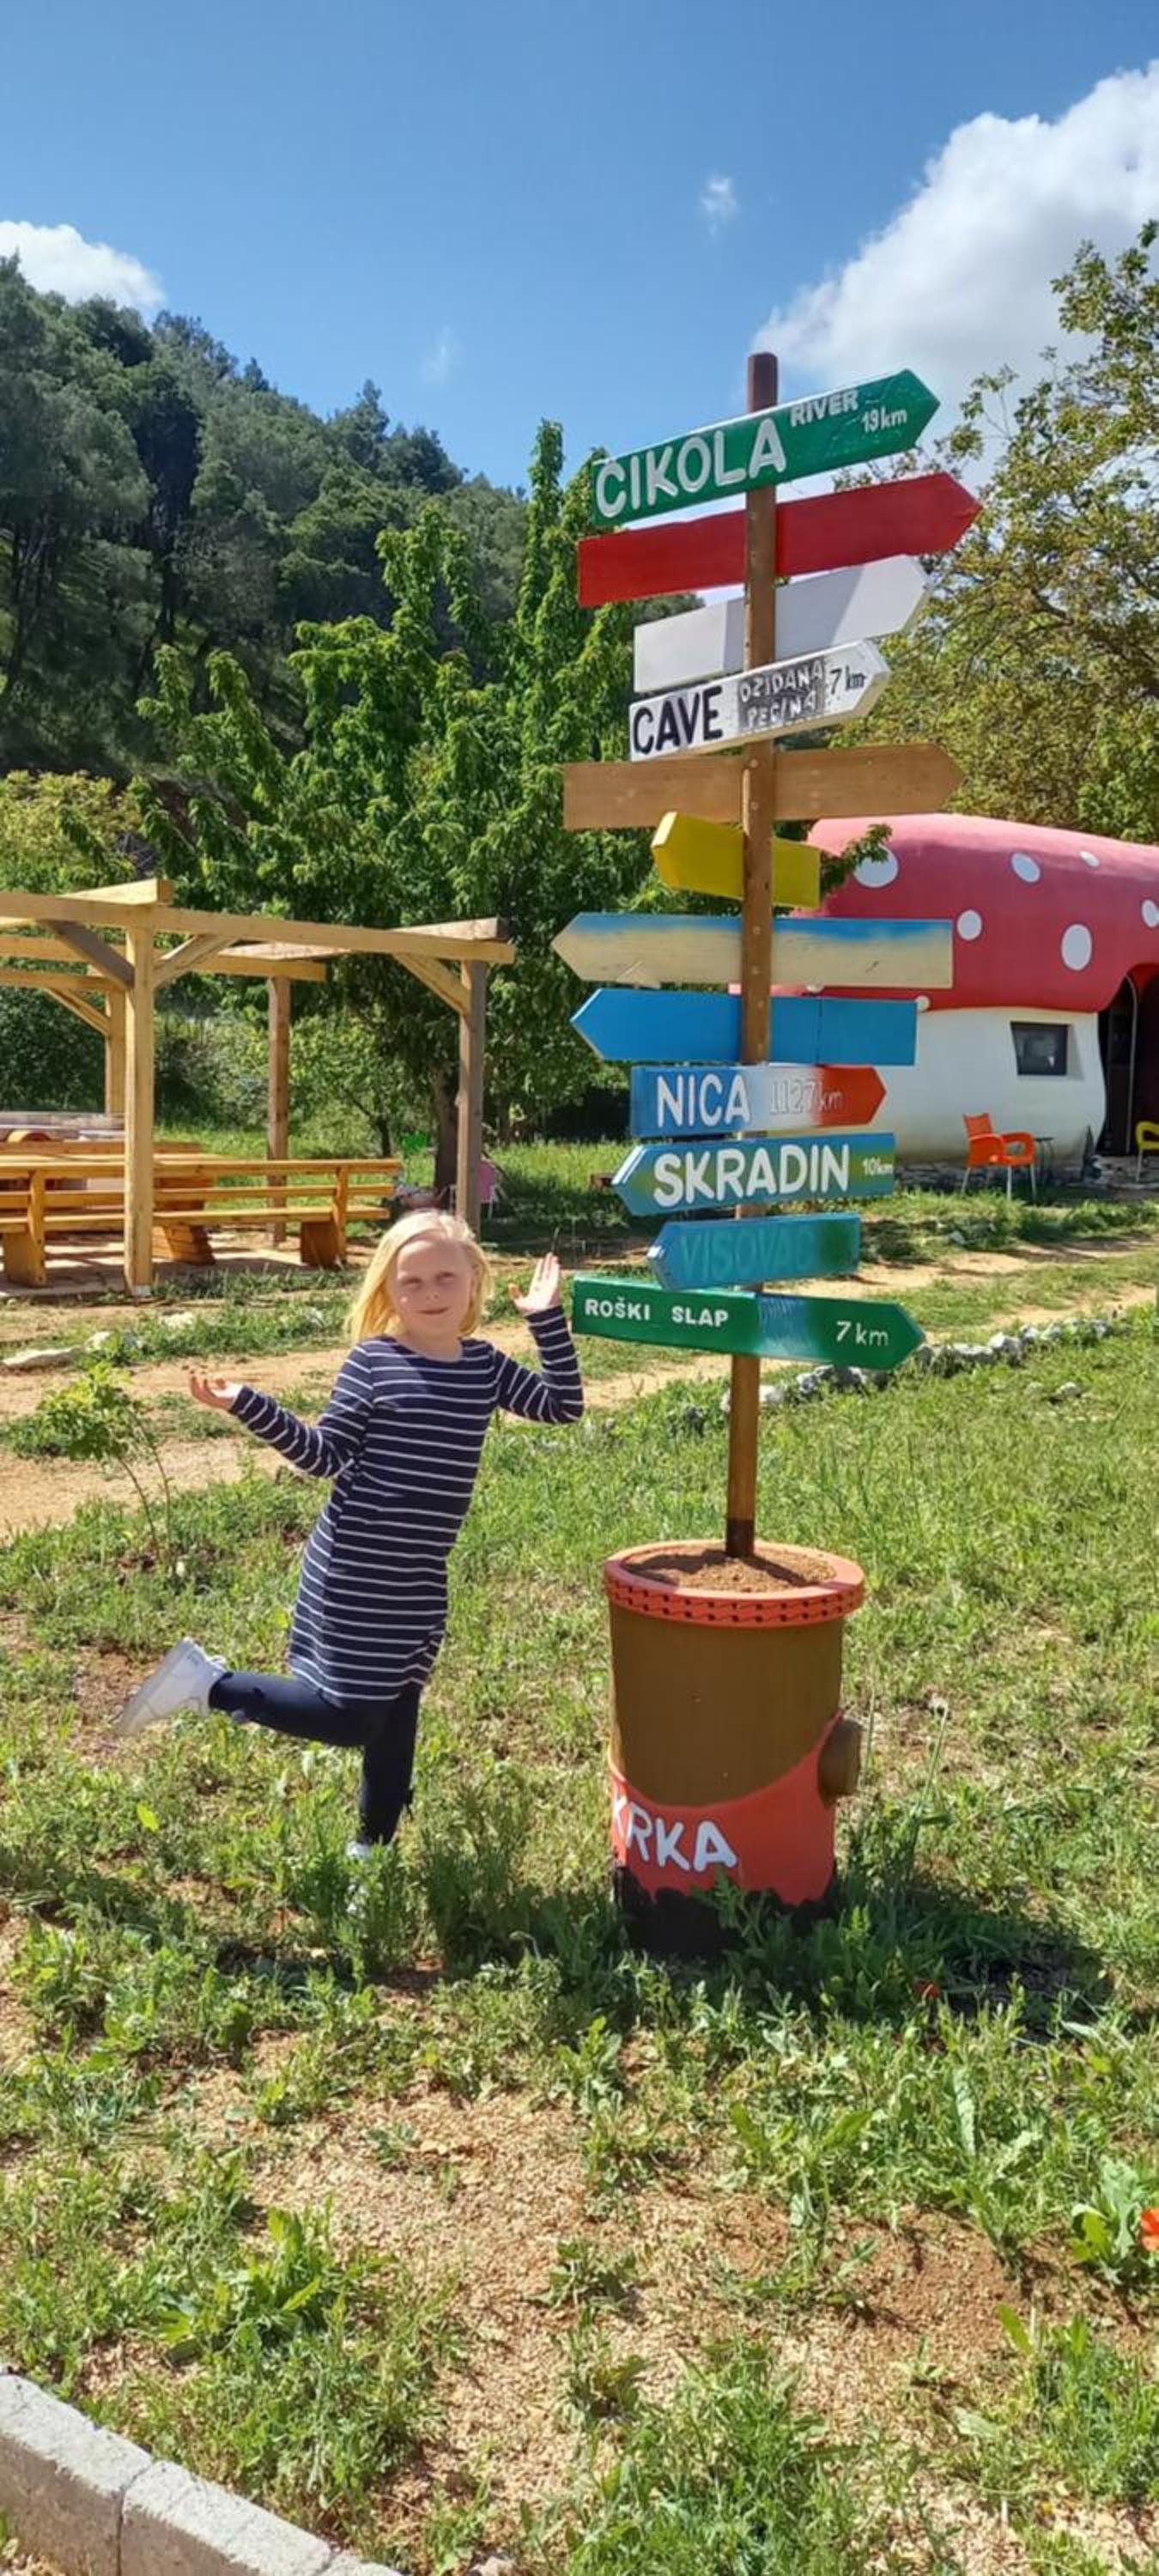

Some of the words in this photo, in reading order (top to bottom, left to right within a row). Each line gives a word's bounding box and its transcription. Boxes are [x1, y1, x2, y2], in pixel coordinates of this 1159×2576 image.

[790, 389, 859, 427] RIVER
[633, 685, 723, 755] CAVE
[656, 1073, 750, 1128] NICA
[652, 1144, 850, 1208] SKRADIN
[584, 1296, 650, 1321] ROŠKI
[671, 1305, 729, 1327] SLAP
